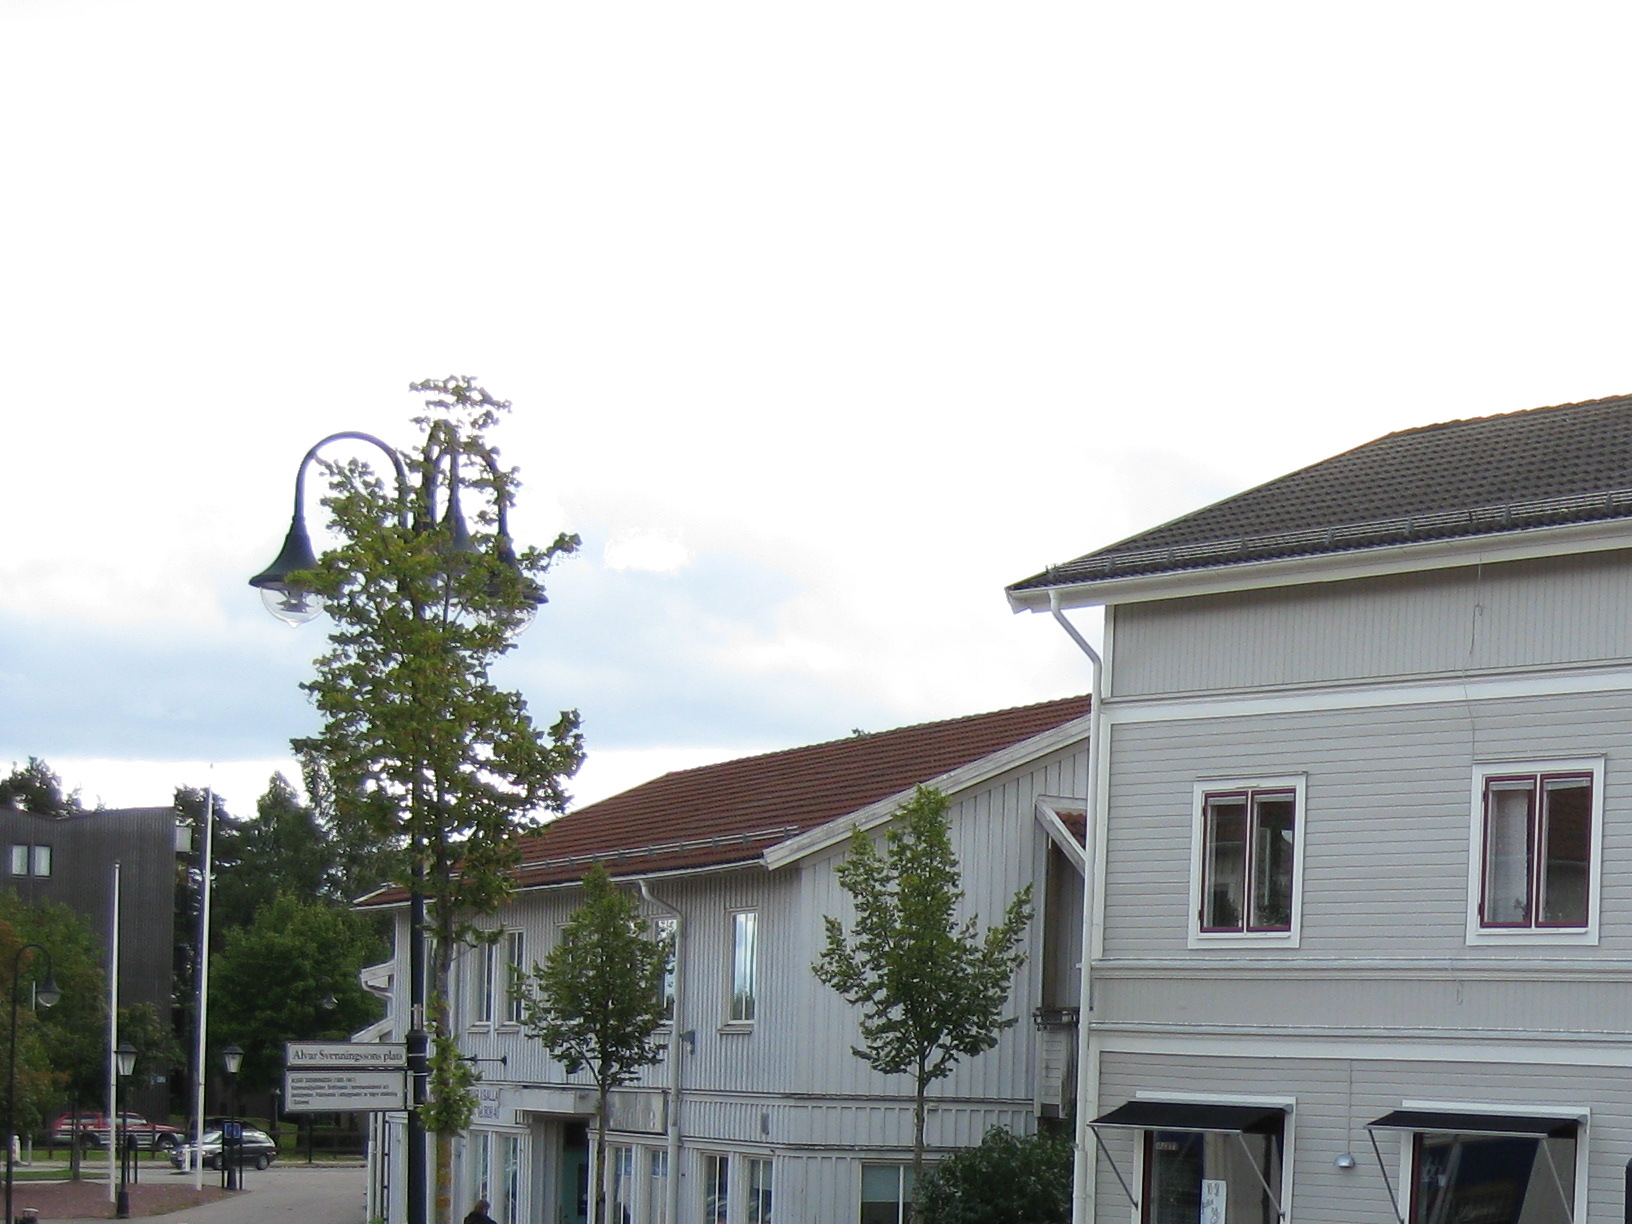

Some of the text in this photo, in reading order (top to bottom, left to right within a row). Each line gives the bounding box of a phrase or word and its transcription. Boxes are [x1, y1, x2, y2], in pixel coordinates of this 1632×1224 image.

[293, 1049, 403, 1062] Alvar Svenningssons plats
